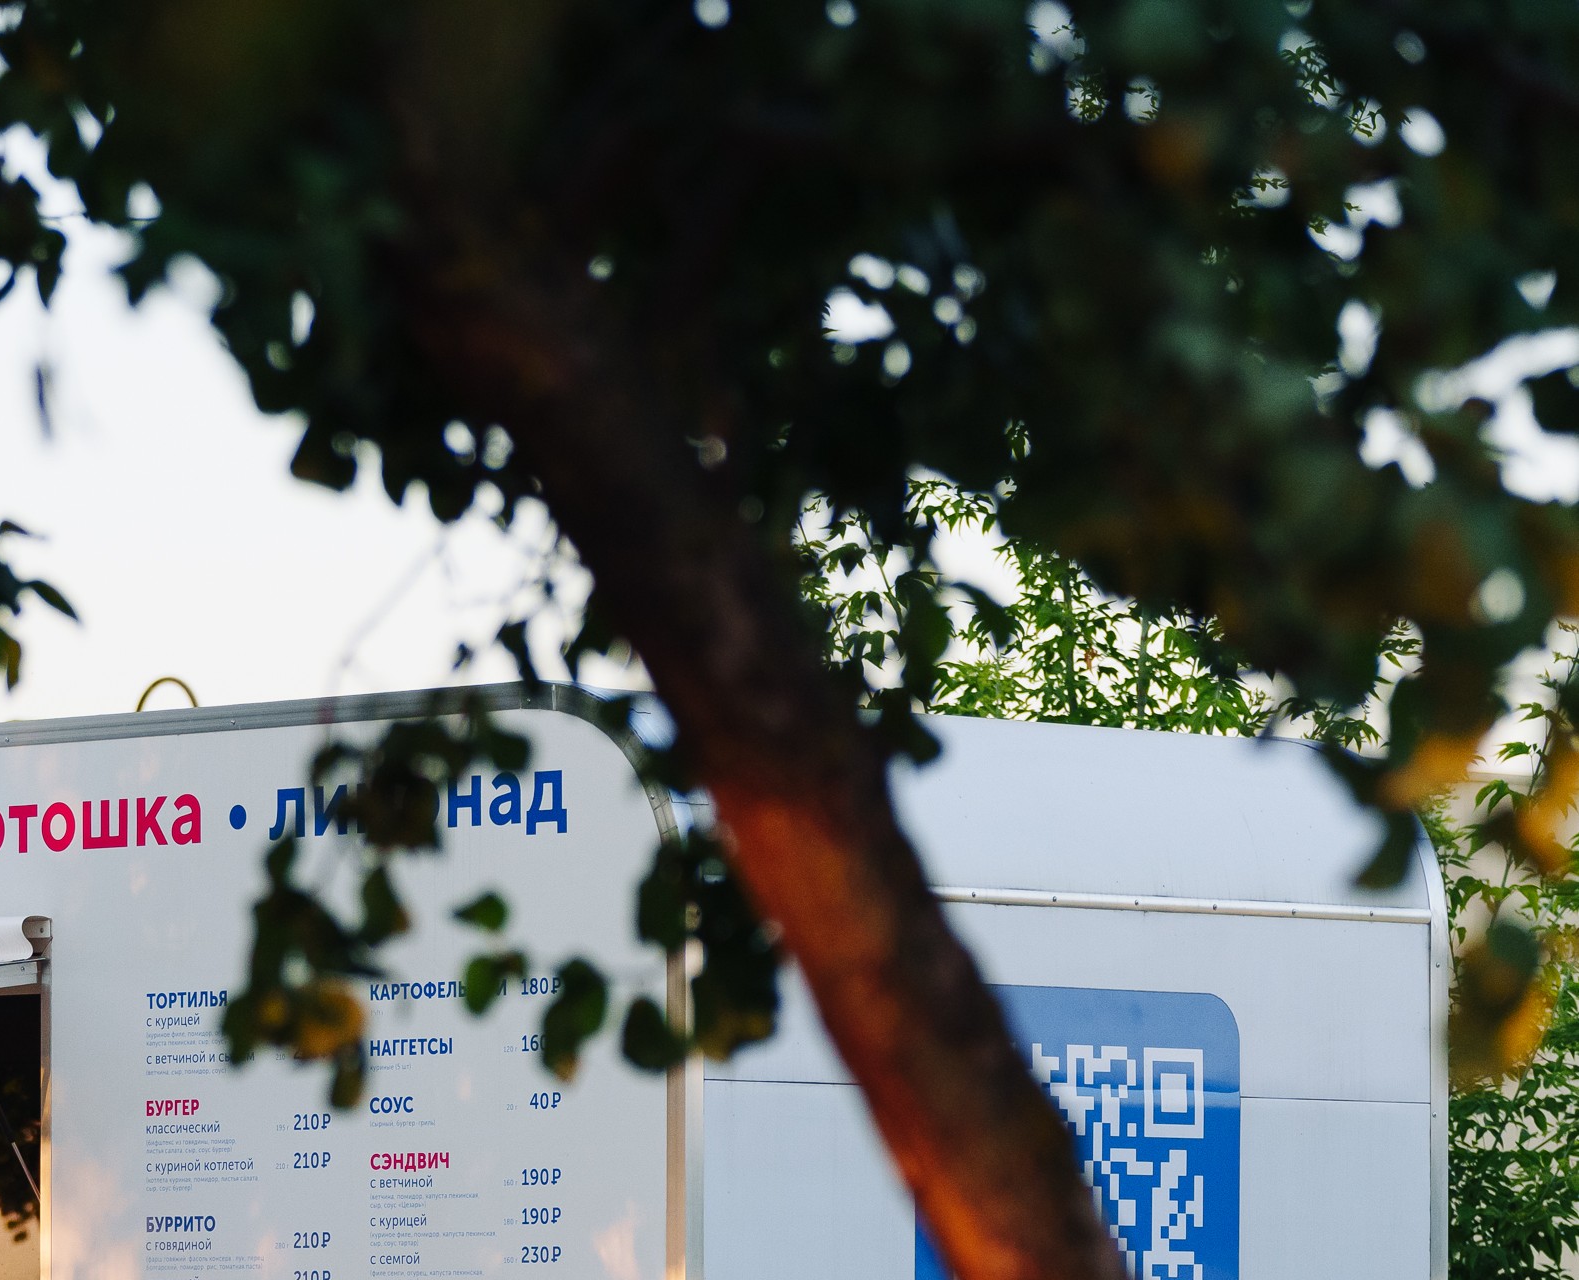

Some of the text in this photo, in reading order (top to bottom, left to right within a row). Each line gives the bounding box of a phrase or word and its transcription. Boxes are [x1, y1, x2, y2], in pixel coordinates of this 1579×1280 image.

[269, 769, 567, 841] линад
[370, 981, 466, 1001] КАРТОФЕЛЬ
[147, 991, 228, 1009] ТОРТИЛЬЯ
[146, 1013, 200, 1029] с курицей
[370, 1038, 453, 1056] НАГГЕТСЫ
[146, 1055, 152, 1064] с
[156, 1051, 205, 1064] ветчиной
[209, 1054, 215, 1062] и
[146, 1099, 199, 1116] БУРГЕР
[370, 1096, 414, 1114] СОУС
[146, 1121, 221, 1134] классический
[146, 1158, 253, 1174] с куриной котлетой
[370, 1152, 450, 1172] СЭНДВИЧ
[370, 1175, 433, 1188] с ветчиной
[146, 1216, 216, 1233] БУРРИТО
[370, 1214, 427, 1230] с курицей
[146, 1238, 212, 1252] с говядиной
[370, 1252, 420, 1265] с семгой
